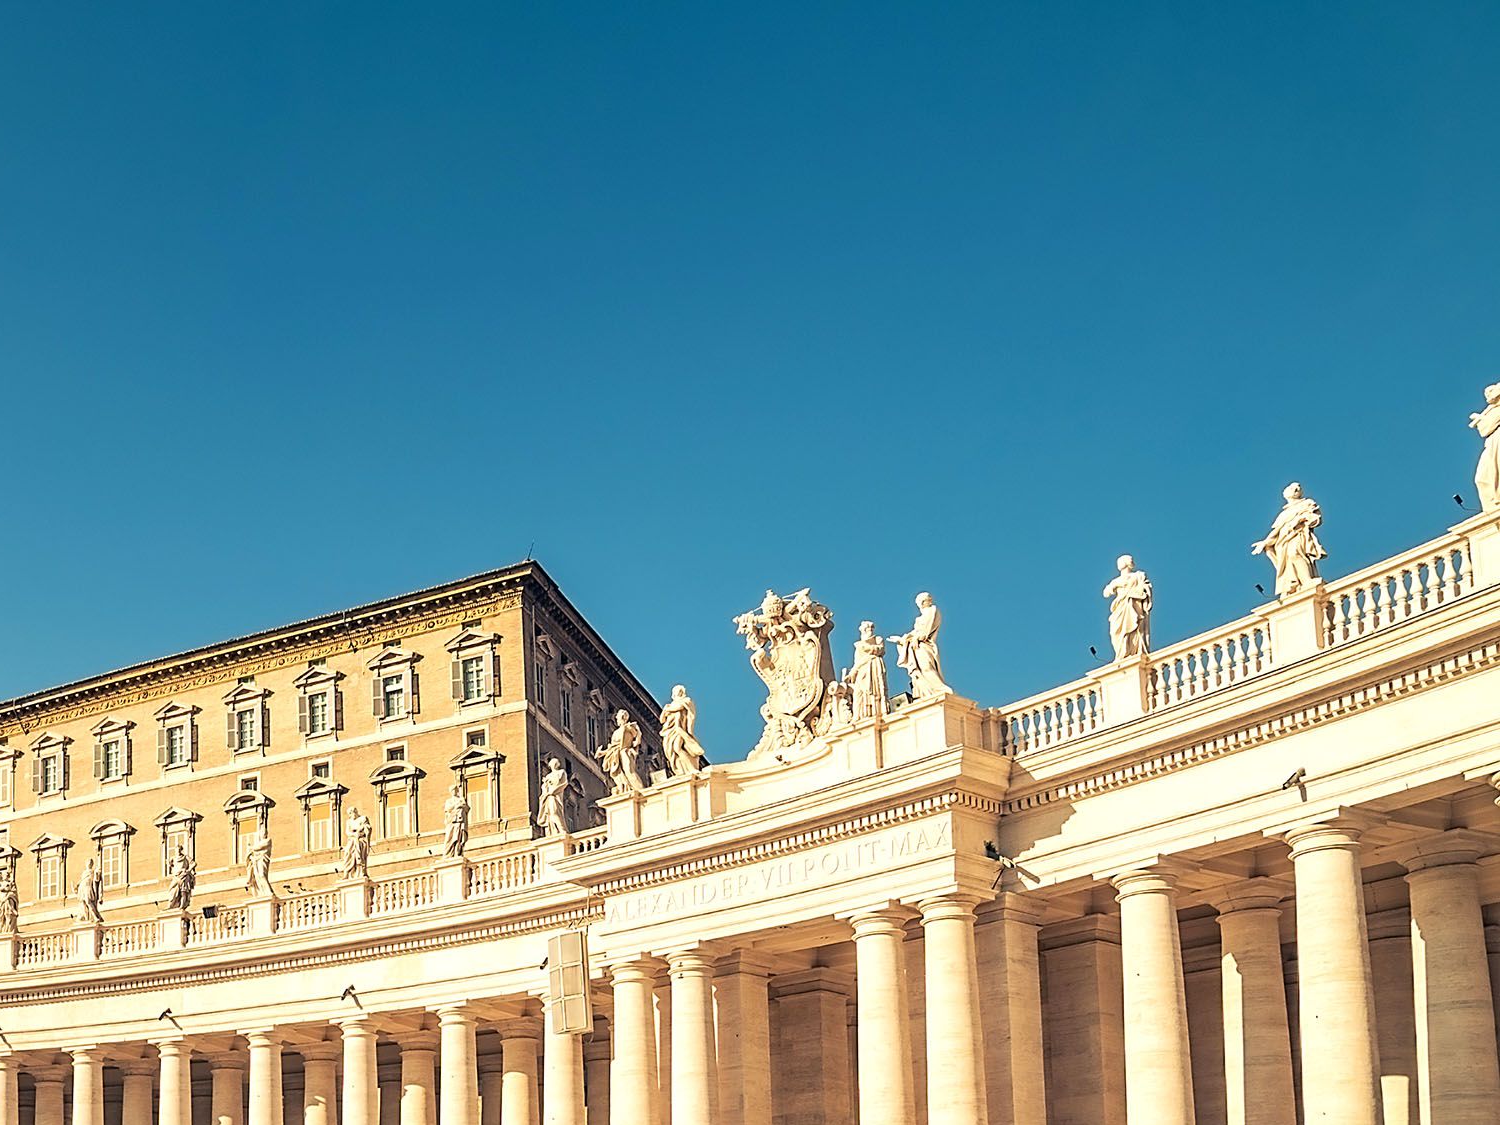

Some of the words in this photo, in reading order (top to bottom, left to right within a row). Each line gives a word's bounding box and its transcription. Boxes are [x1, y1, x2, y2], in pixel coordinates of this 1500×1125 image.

[608, 874, 750, 924] ALEXANDER
[760, 861, 794, 890] VII
[803, 840, 881, 882] PONT
[891, 821, 950, 859] MAX
